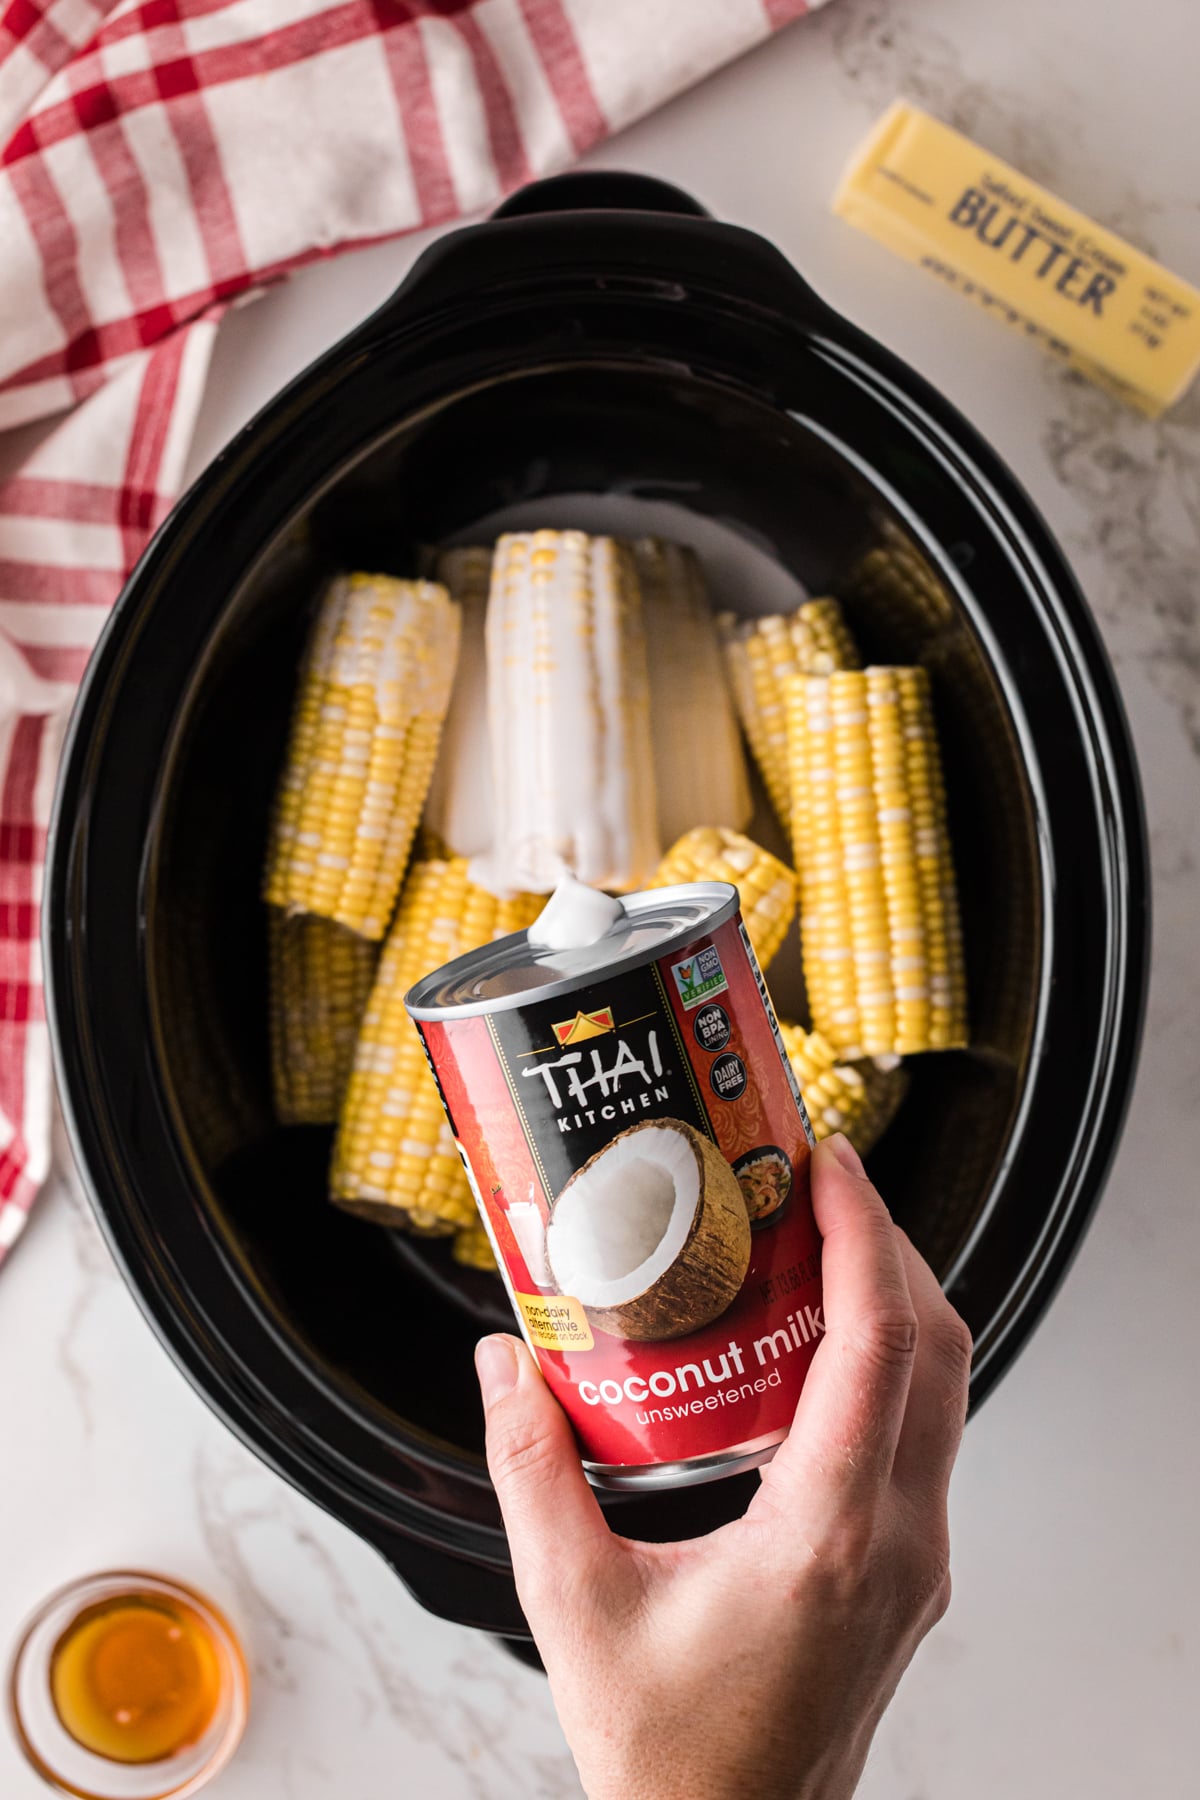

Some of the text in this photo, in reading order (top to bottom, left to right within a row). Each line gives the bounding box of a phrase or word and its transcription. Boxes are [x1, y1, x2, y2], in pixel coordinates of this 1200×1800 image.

[949, 187, 1117, 317] BUTTER
[698, 950, 716, 964] NON
[701, 958, 719, 972] GMO
[683, 974, 724, 1000] VERIFIED
[698, 1009, 721, 1028] NON
[702, 1020, 725, 1039] BPA
[704, 1029, 728, 1047] LINING
[521, 1030, 663, 1109] THAI
[714, 1060, 740, 1084] DAIRY
[718, 1073, 743, 1093] FREE
[557, 1085, 669, 1133] KITCHEN
[525, 1305, 570, 1320] non-dairy
[528, 1318, 578, 1331] alternative
[569, 1331, 588, 1340] back
[578, 1305, 826, 1405] coconut milk
[636, 1368, 782, 1426] unsweetened
